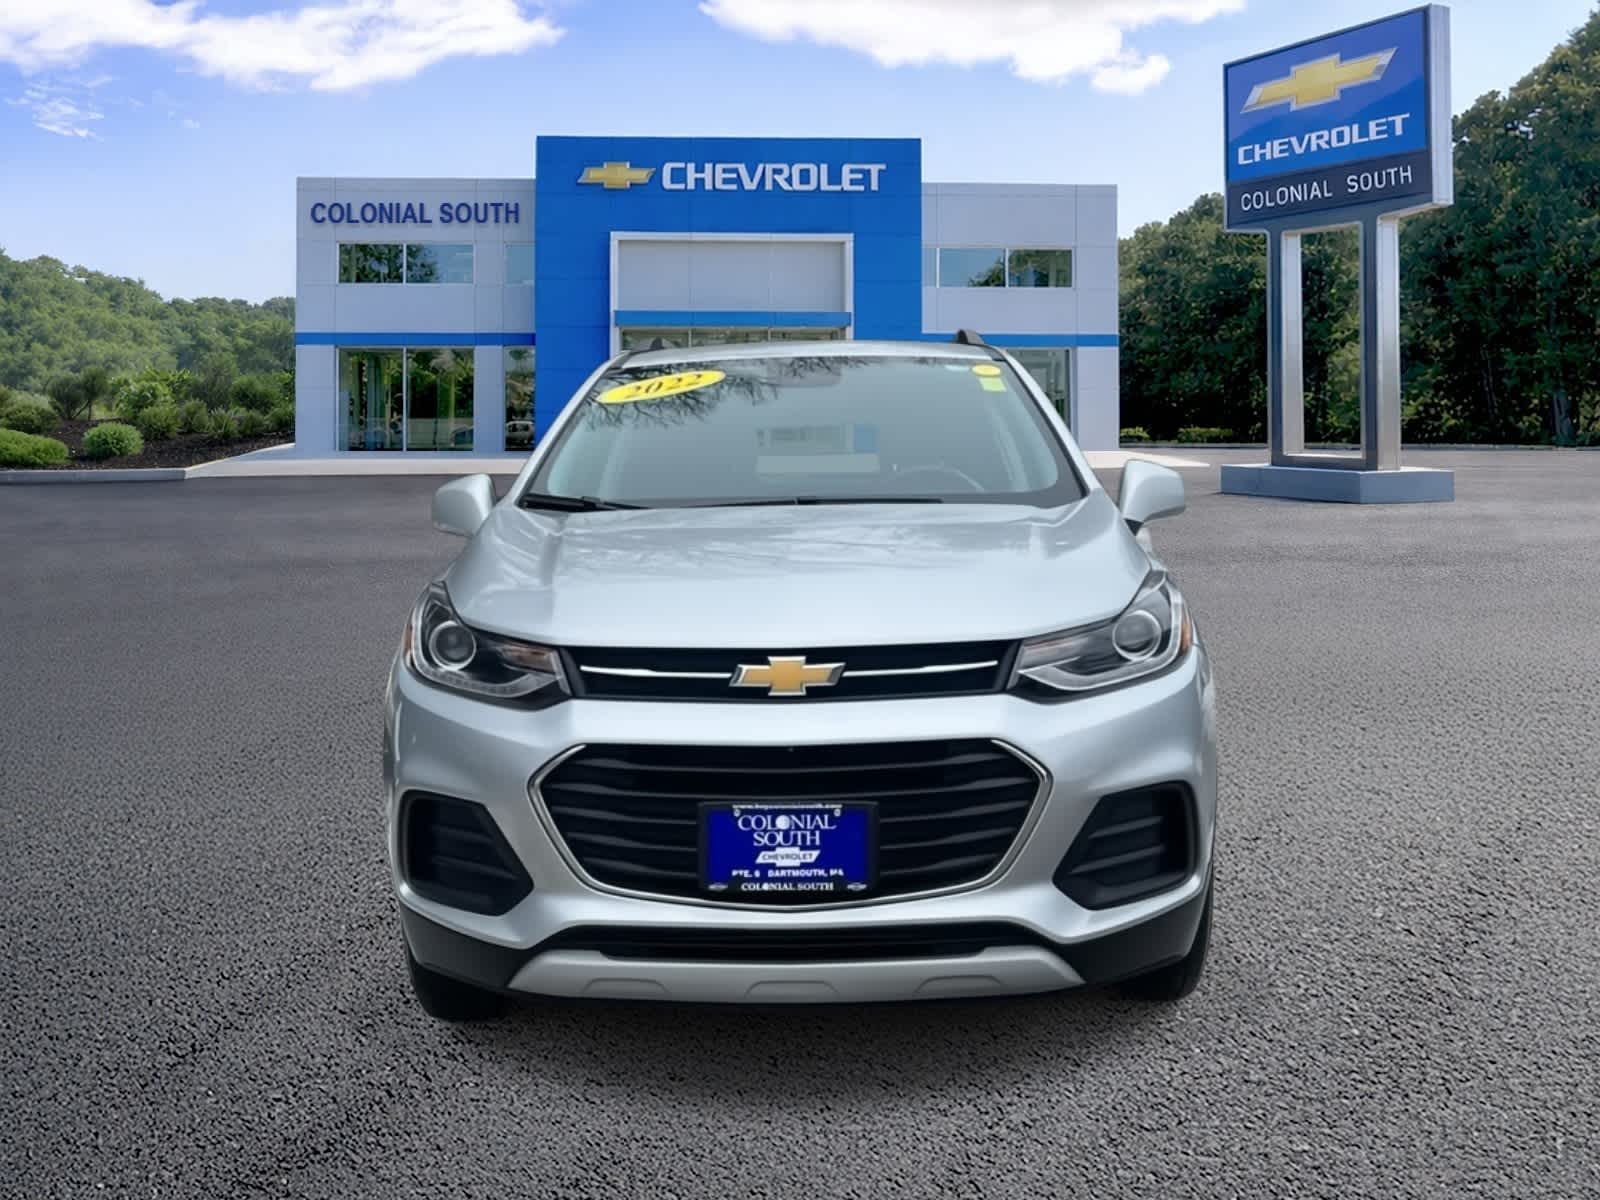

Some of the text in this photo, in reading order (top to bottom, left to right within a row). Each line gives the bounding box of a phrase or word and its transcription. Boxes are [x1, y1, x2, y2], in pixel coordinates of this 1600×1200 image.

[1237, 113, 1410, 165] CHEVROLET
[662, 162, 887, 192] CHEVROLET
[1240, 165, 1413, 211] COLONIAL SOUTH
[310, 202, 520, 225] COLONIAL SOUTH
[624, 374, 703, 399] 2022
[738, 814, 837, 831] COLONIAL
[753, 830, 821, 847] SOUTH
[761, 852, 814, 861] CHEVROLET
[767, 869, 828, 878] DARTMOUTH,
[740, 882, 835, 891] COLONIAL SOUTH
